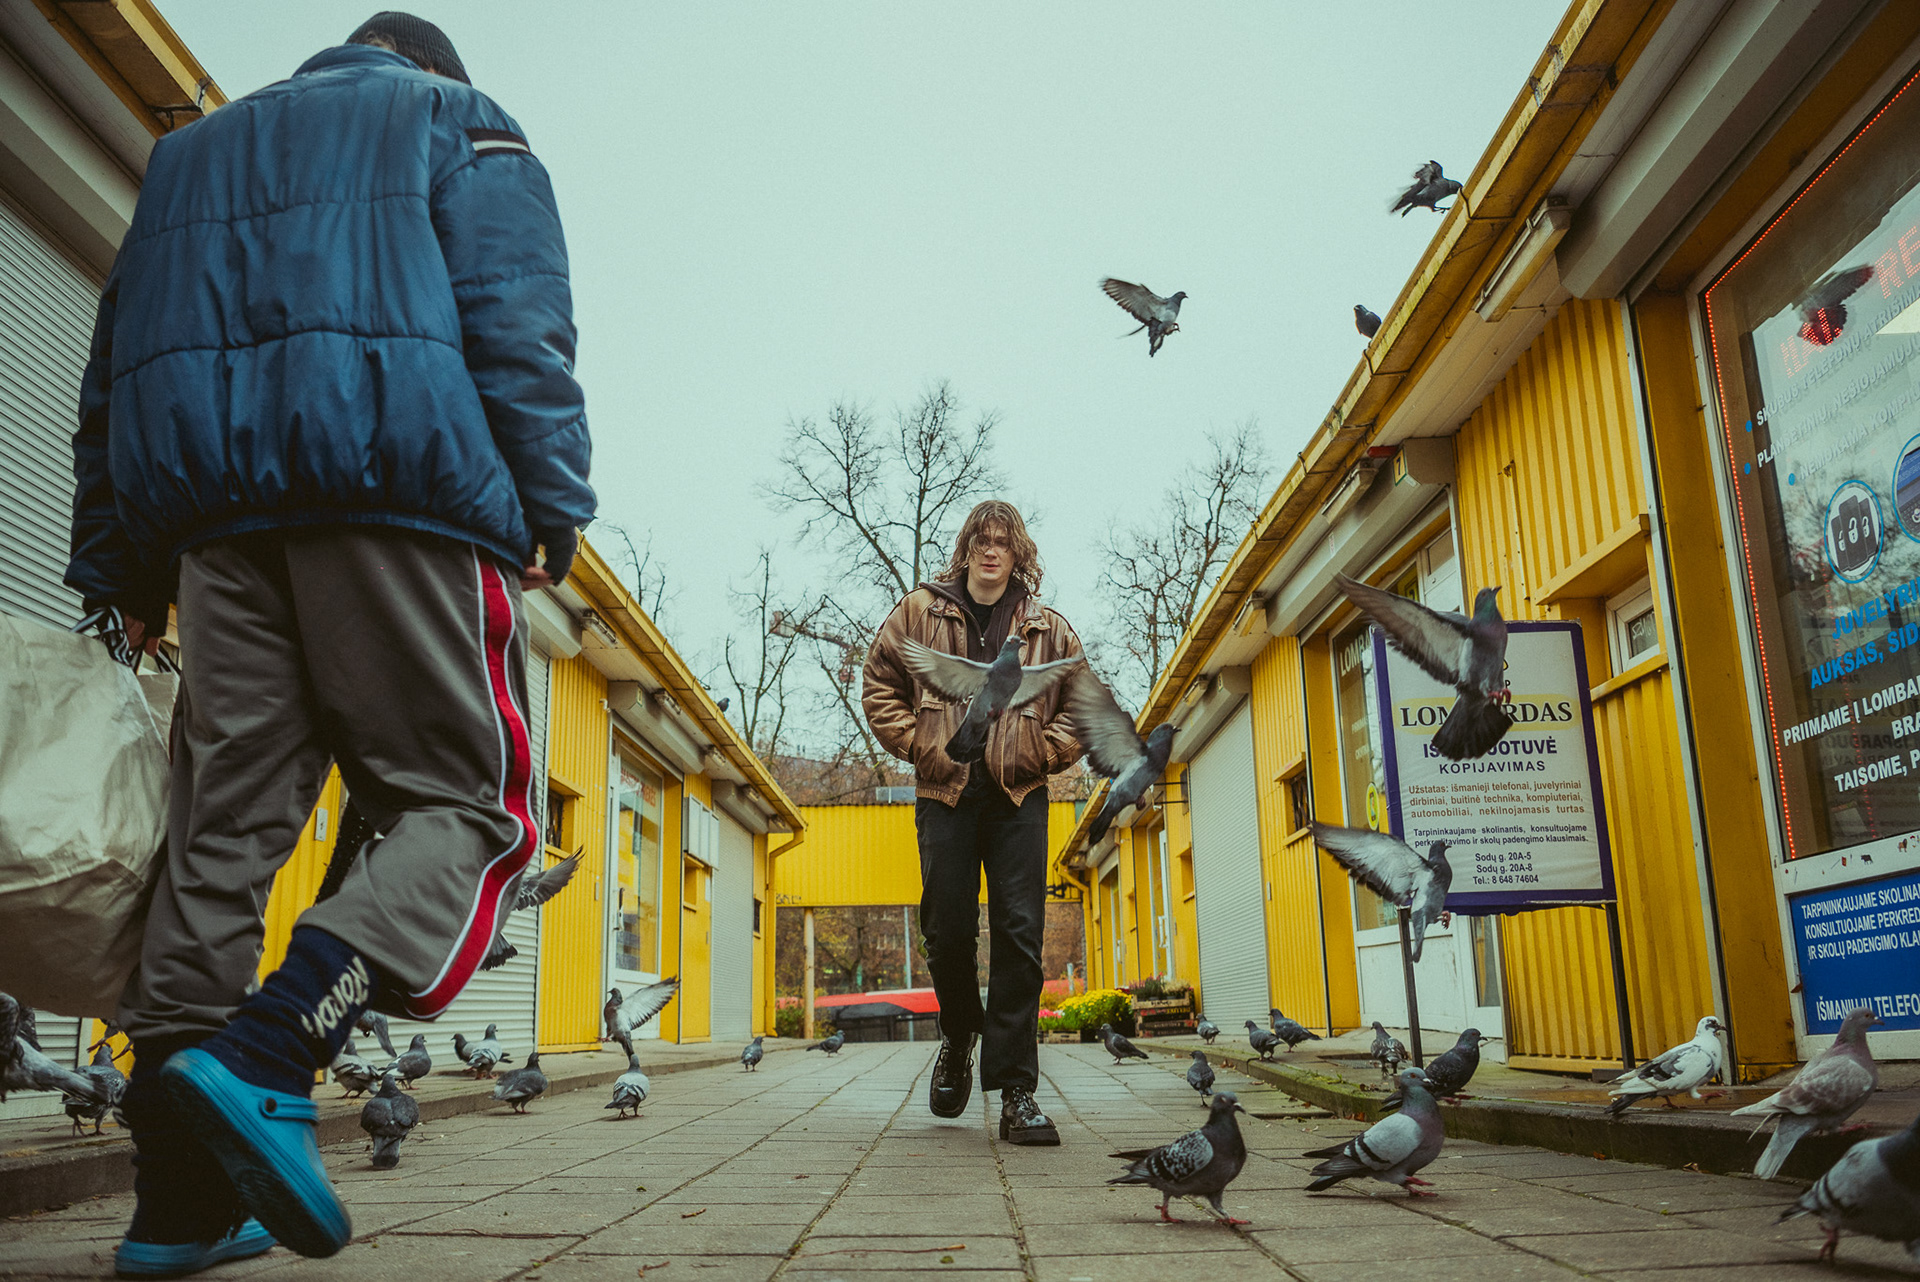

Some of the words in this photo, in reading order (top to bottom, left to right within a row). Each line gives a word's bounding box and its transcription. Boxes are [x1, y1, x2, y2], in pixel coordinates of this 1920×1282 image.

[1756, 383, 1800, 426] SKUBUS
[1832, 576, 1920, 640] JUVELYRI
[1811, 641, 1884, 689] AUKSAS,
[1400, 702, 1573, 727] LORDAS
[1783, 705, 1851, 747] PRIIMAME
[1853, 701, 1861, 724] Į
[1439, 760, 1546, 775] KOPIJAVIMAS
[1834, 755, 1908, 793] TAISOME,
[1408, 785, 1449, 795] Užstatas:
[1451, 782, 1490, 793] išmanieji
[1492, 781, 1532, 791] telefonai,
[1533, 780, 1582, 792] juvelyriniai
[1410, 796, 1448, 806] dirbiniai,
[1450, 795, 1481, 805] buitinė
[1483, 793, 1524, 804] technika,
[1526, 791, 1583, 803] kompiuteriai,
[1411, 807, 1473, 818] automobiliai,
[1479, 805, 1550, 817] nekilnojamasis
[1556, 805, 1585, 814] turtas
[1413, 826, 1477, 837] Tarpininkaujame
[1481, 825, 1526, 834] skolinantis,
[1530, 824, 1588, 834] konsultuojame
[1472, 837, 1479, 845] ir
[1480, 836, 1501, 846] skolų
[1502, 835, 1544, 845] padengimo
[1545, 834, 1589, 843] klausimais.
[1475, 852, 1497, 863] Sodų
[1498, 854, 1507, 863] g.
[1508, 851, 1532, 860] 20A-5
[1476, 864, 1498, 874] Sodų
[1500, 865, 1508, 874] g.
[1509, 863, 1533, 872] 20A-8
[1472, 875, 1490, 884] Tel.:
[1491, 875, 1497, 884] 8
[1499, 875, 1513, 884] 648
[1801, 892, 1878, 919] TARPININKAUJAME
[1804, 914, 1877, 940] KONSULTUOJAME
[1807, 945, 1818, 960] IR
[1817, 940, 1845, 960] SKOLŲ
[1846, 933, 1898, 955] PADENGIMO
[1899, 930, 1920, 948] KLA
[1874, 993, 1920, 1018] TELEFO
